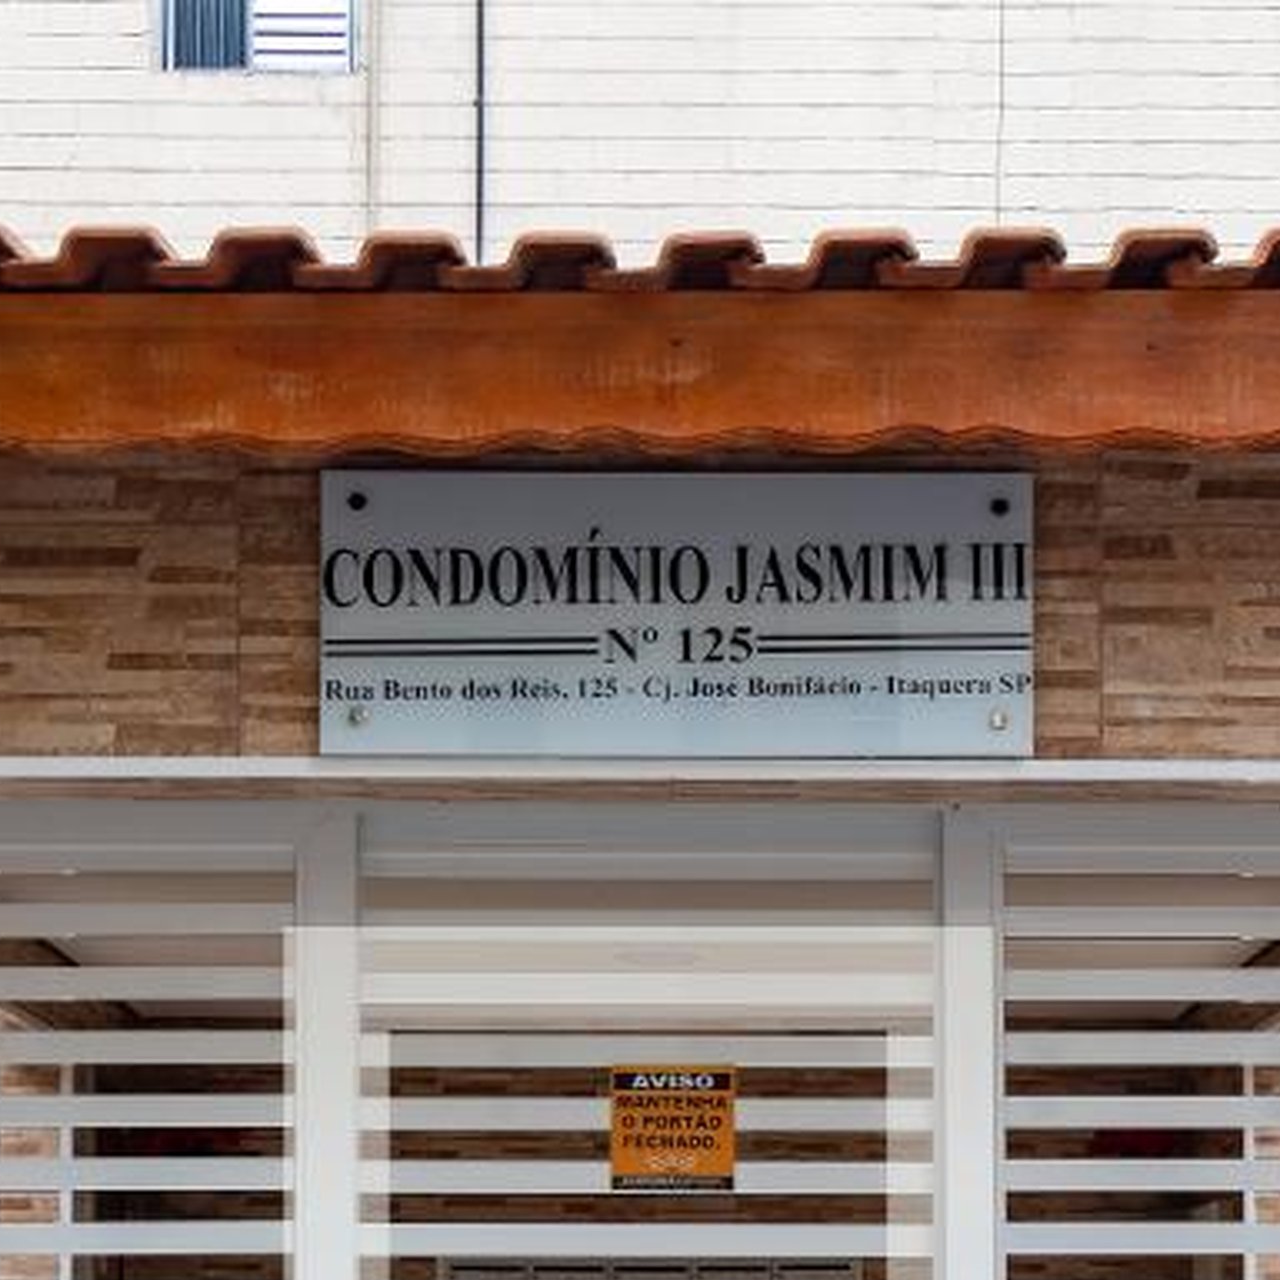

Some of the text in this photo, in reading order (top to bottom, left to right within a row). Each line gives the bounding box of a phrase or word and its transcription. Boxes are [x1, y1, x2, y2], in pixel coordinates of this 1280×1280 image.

[322, 528, 1029, 608] CONDOMÍNIO JASMIM III
[678, 627, 754, 664] 125
[324, 680, 375, 700] Rua
[383, 680, 452, 700] Bento
[460, 680, 502, 700] dos
[578, 677, 619, 699] 125
[686, 677, 738, 698] José
[747, 676, 862, 698] Bonifácio
[887, 676, 992, 700] Itaquera
[999, 675, 1032, 694] SP
[632, 1074, 715, 1089] AVISO
[616, 1095, 727, 1110] MANTENHA
[622, 1114, 722, 1130] O PORTÃO
